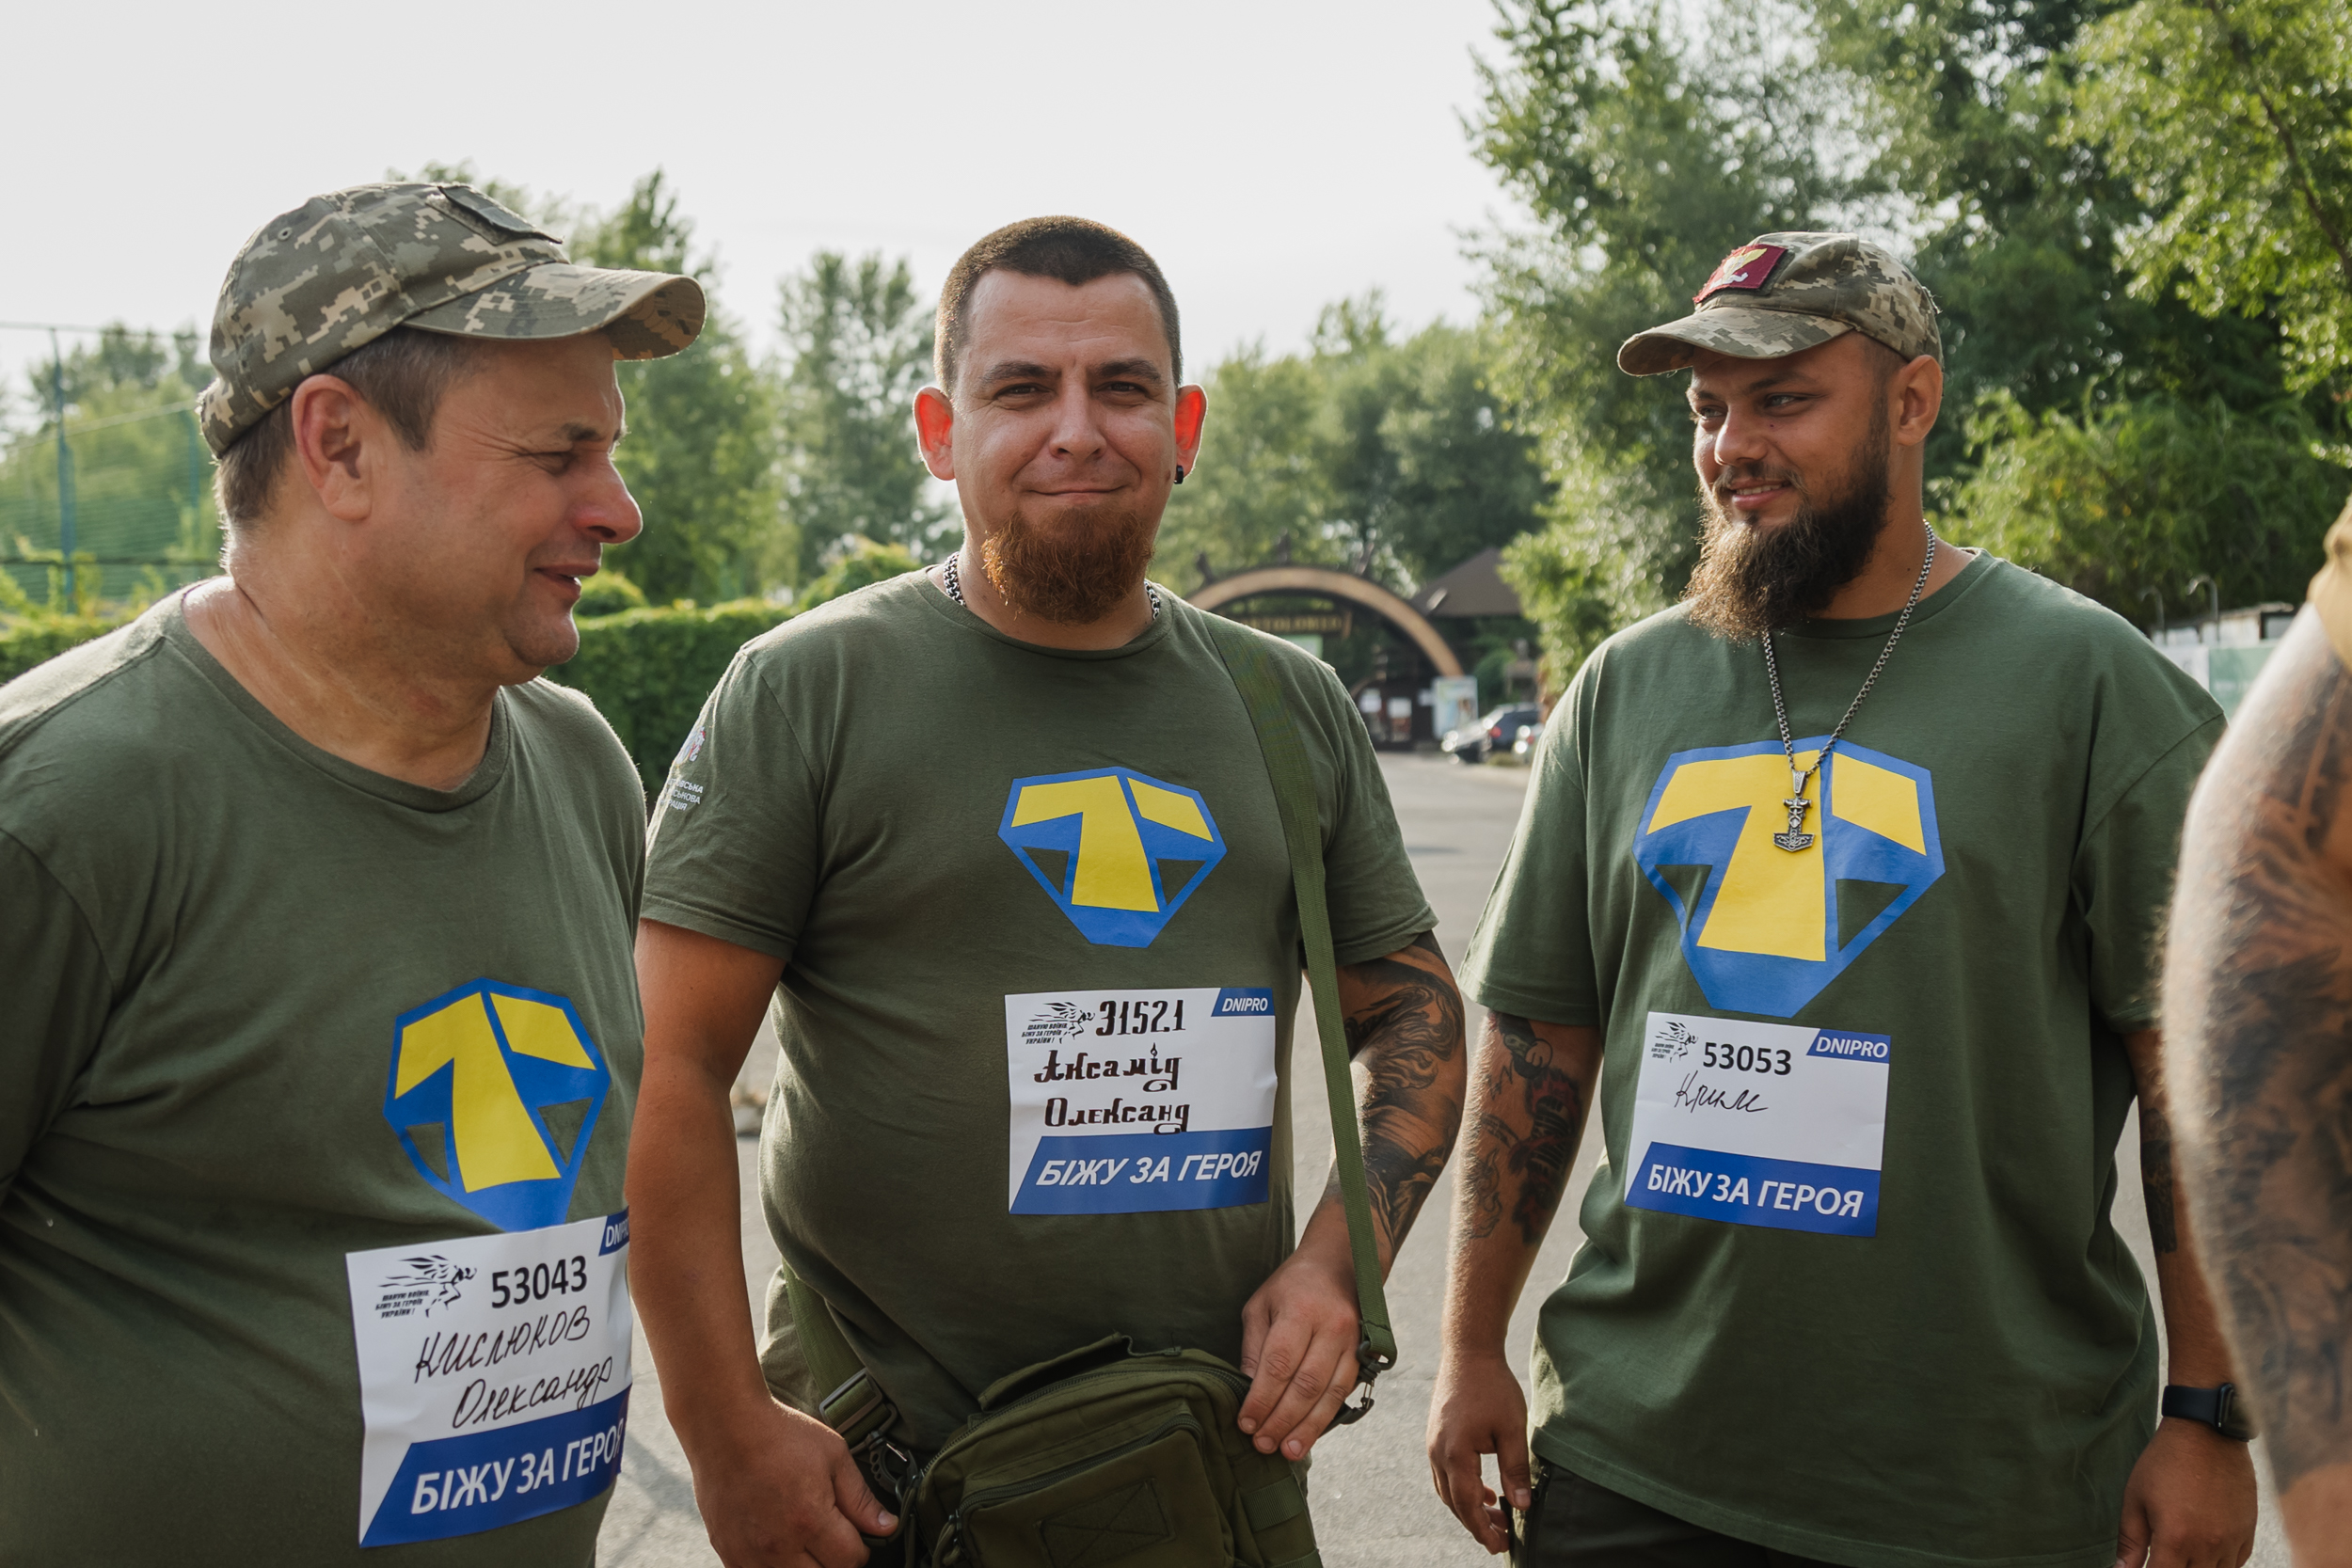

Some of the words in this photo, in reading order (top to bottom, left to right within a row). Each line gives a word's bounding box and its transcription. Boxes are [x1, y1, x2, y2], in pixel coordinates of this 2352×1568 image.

[1095, 999, 1186, 1037] 31521
[1221, 997, 1269, 1013] DNIPRO
[1702, 1041, 1792, 1076] 53053
[1815, 1036, 1888, 1059] DNIPRO
[1035, 1157, 1130, 1187] БІЖУ
[1130, 1155, 1170, 1185] ЗА
[1177, 1149, 1263, 1182] ГЕРОЯ
[1646, 1163, 1713, 1198] БІЖУ
[1711, 1173, 1750, 1206] ЗА
[1756, 1180, 1865, 1218] ГЕРОЯ
[490, 1254, 588, 1309] 53043
[410, 1458, 516, 1515] БІЖУ
[516, 1448, 555, 1494] ЗА
[562, 1417, 625, 1482] ГЕРОЯ
